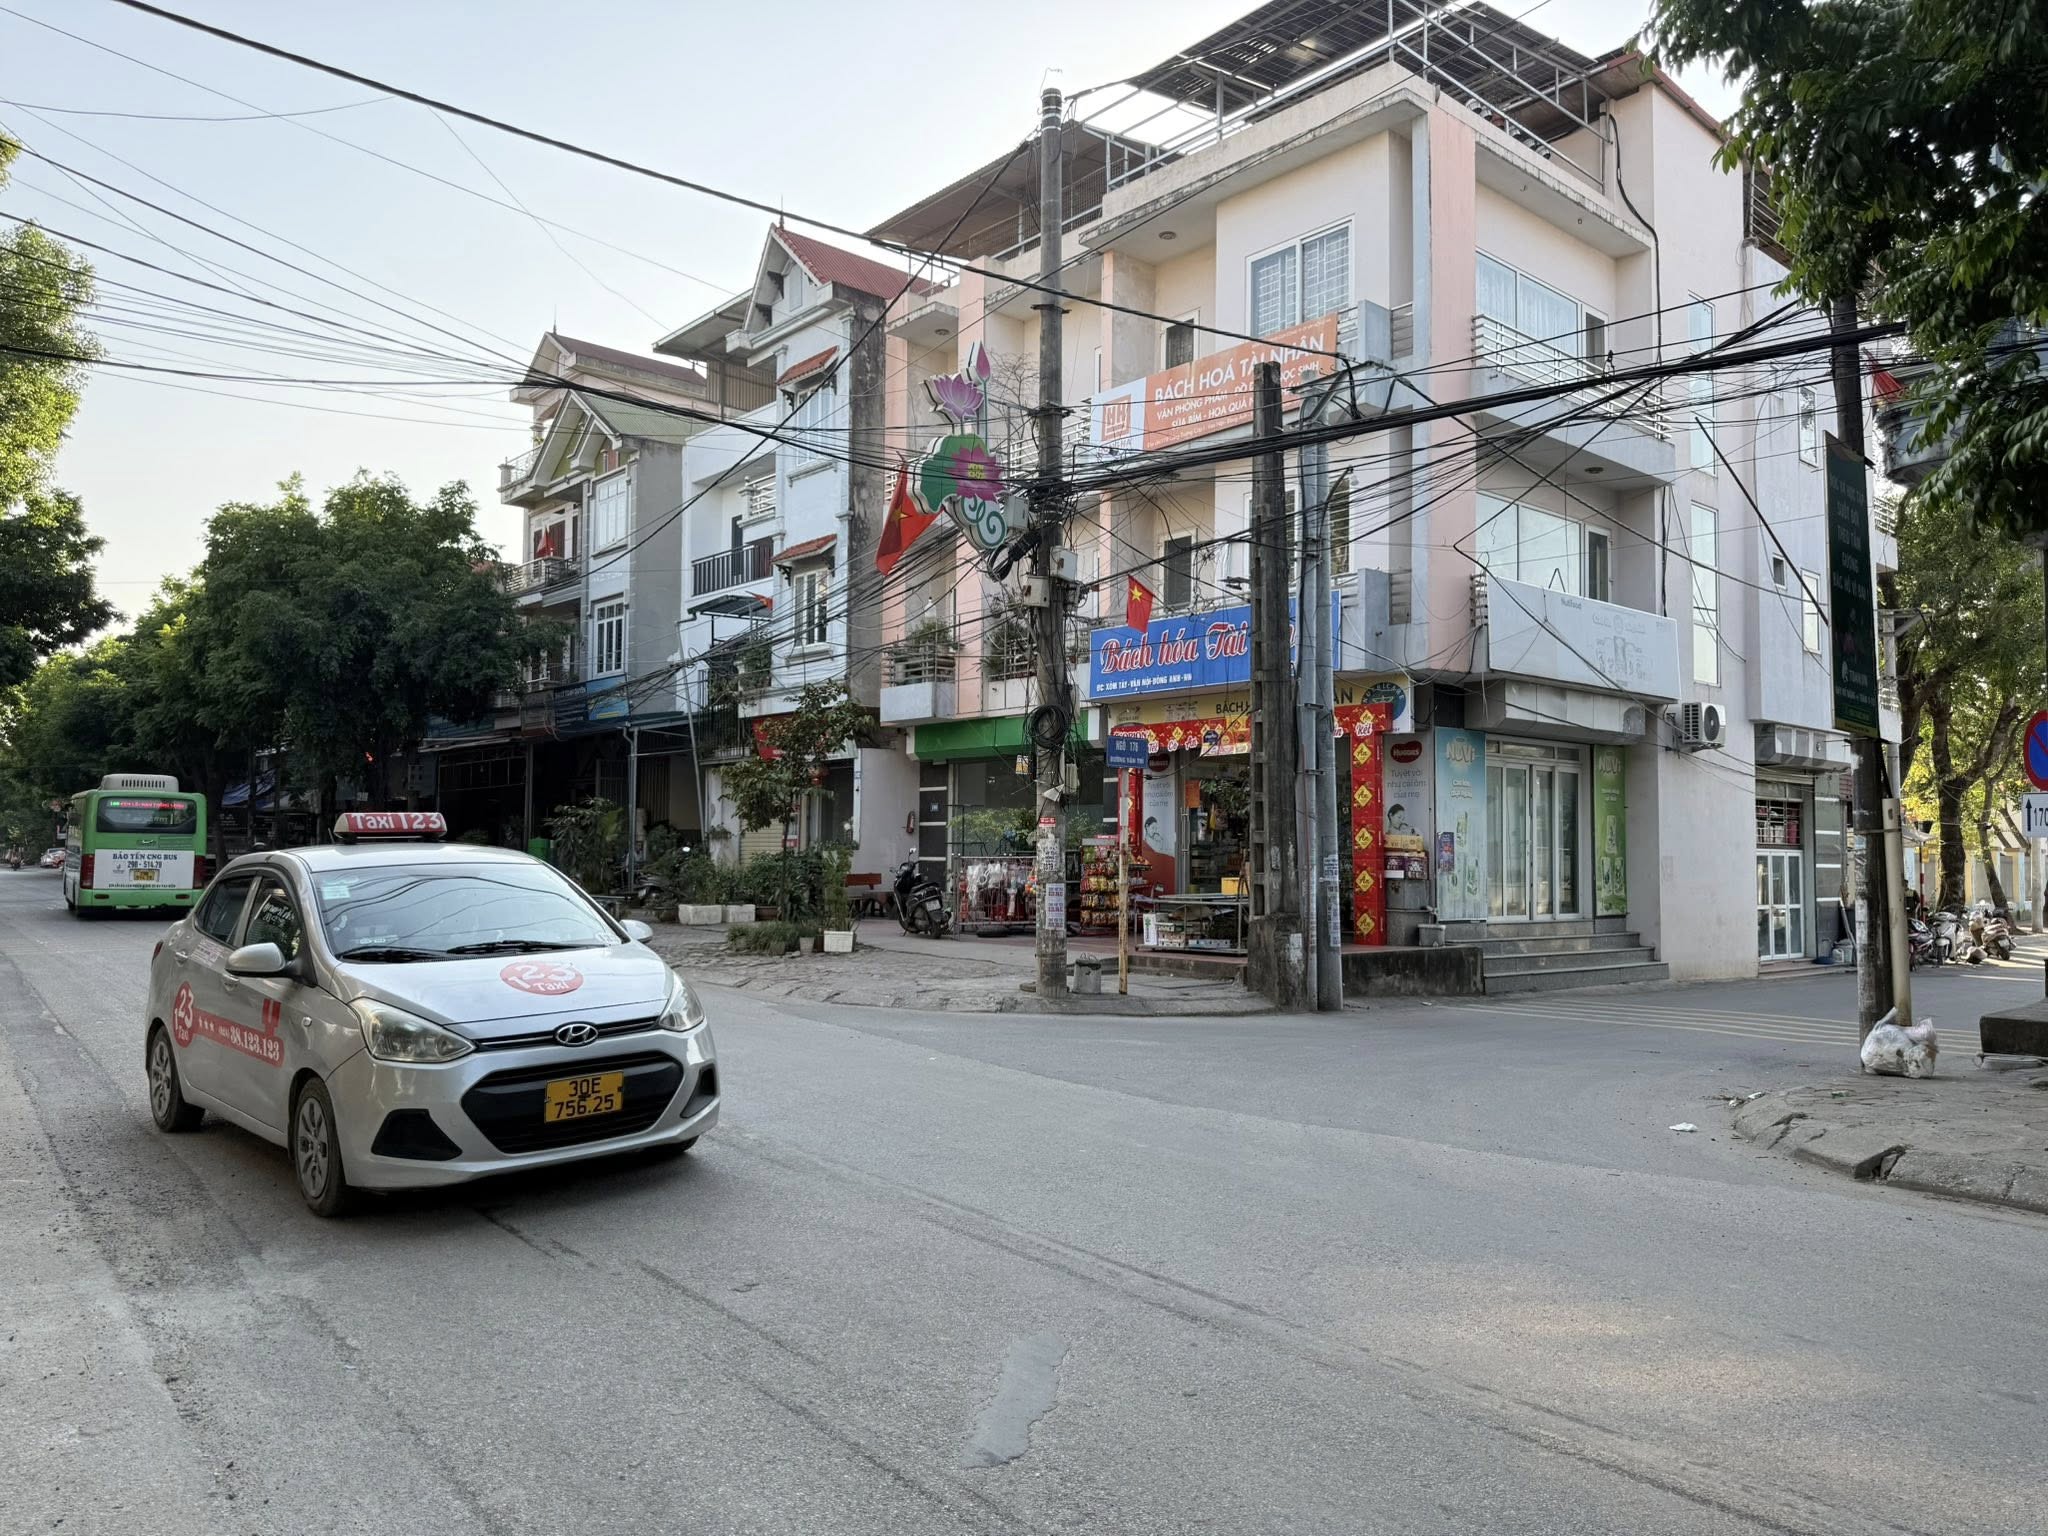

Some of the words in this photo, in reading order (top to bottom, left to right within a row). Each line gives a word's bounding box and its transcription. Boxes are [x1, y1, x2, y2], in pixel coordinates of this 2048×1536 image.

[1154, 376, 1195, 405] BÁCH
[1199, 357, 1235, 391] HOÁ
[1270, 333, 1324, 364] NHÂN
[1175, 398, 1203, 417] PHÒNG
[1208, 405, 1226, 418] HOA
[1101, 632, 1154, 674] Bách
[1157, 627, 1199, 666] hóa
[1205, 620, 1248, 660] Tài
[1215, 701, 1242, 715] BÁCH
[351, 813, 396, 829] Taxi
[400, 813, 440, 829] 123
[508, 962, 577, 990] 123
[533, 980, 569, 992] Taxi
[174, 987, 194, 1031] 123
[230, 1026, 280, 1062] 38.123.123
[568, 1077, 602, 1097] 30E
[555, 1094, 614, 1119] 756.25
